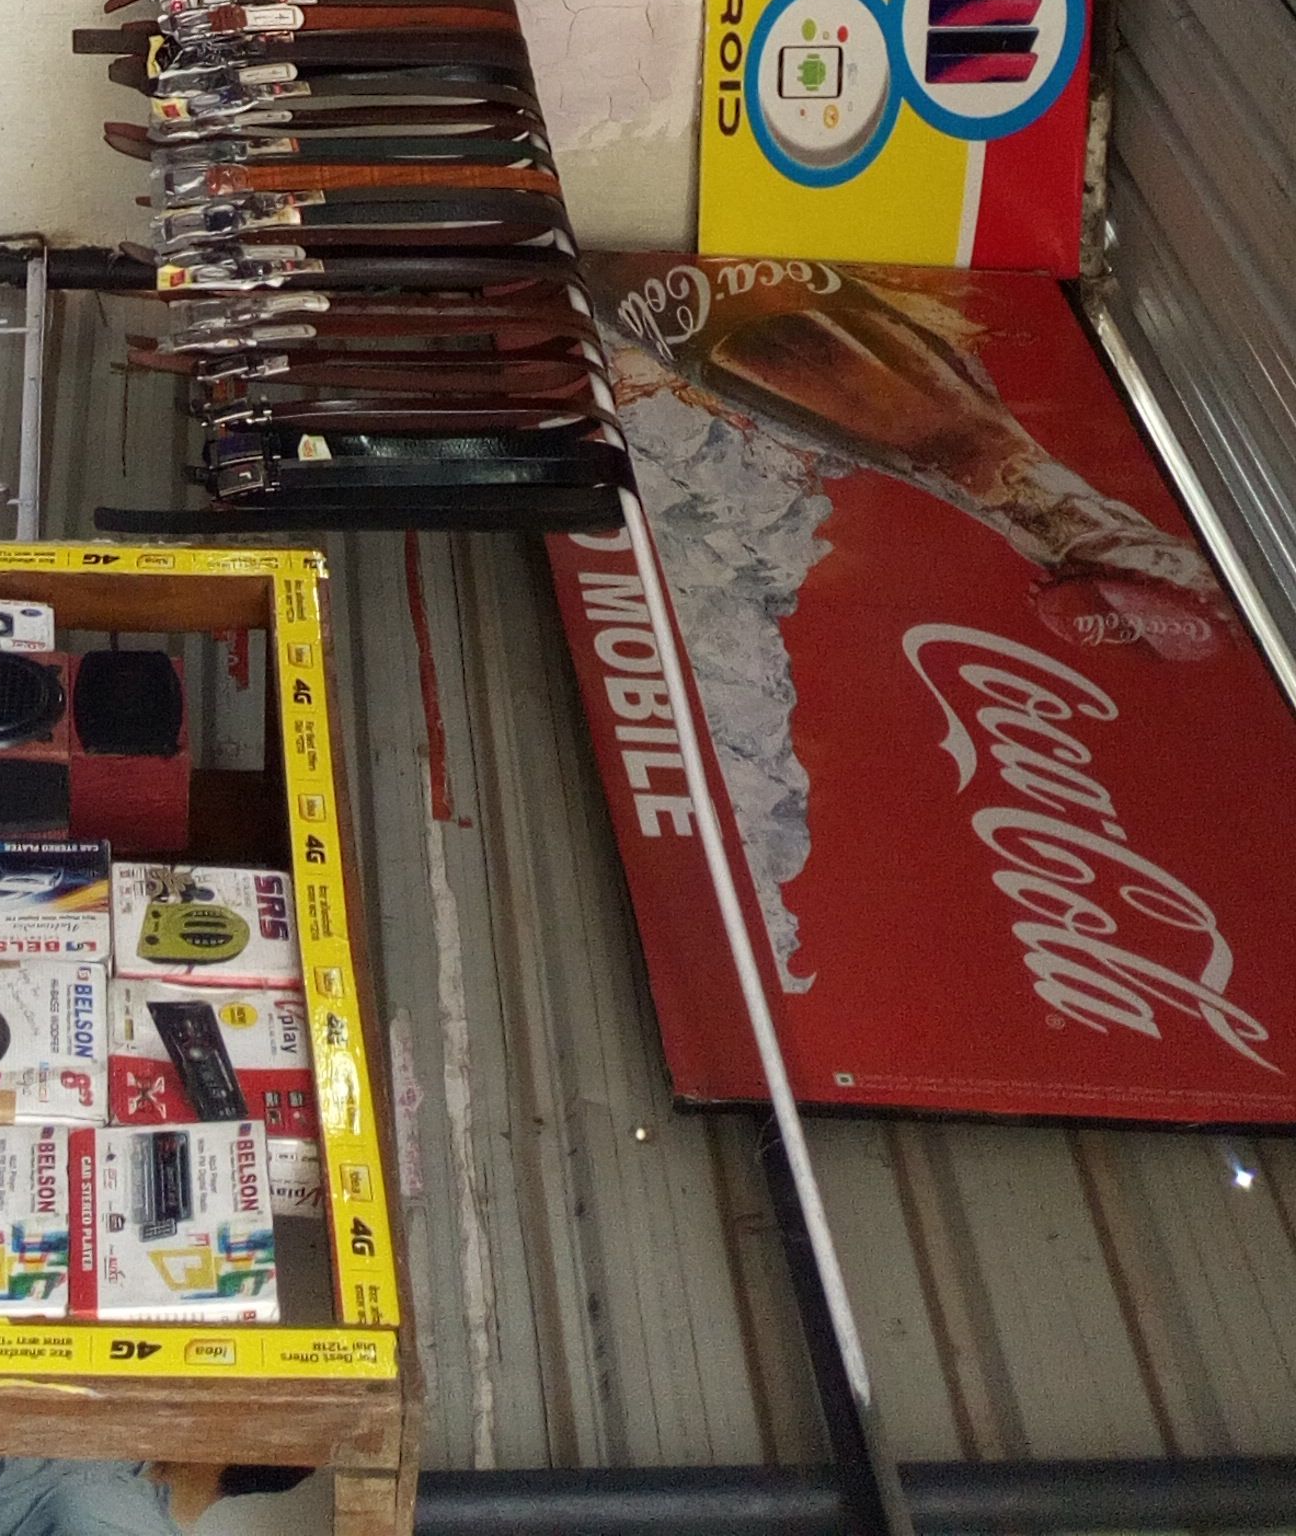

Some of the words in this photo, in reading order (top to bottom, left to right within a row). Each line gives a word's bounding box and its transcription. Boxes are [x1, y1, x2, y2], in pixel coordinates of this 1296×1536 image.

[293, 678, 313, 705] 4G
[577, 572, 700, 838] MOBILE
[305, 834, 326, 864] 4G
[902, 622, 1284, 1076] Coca-Cola
[50, 1015, 61, 1054] WOOFER
[74, 984, 94, 1058] BELSON
[37, 1143, 56, 1213] BELSON
[81, 1155, 92, 1181] CAR
[236, 1139, 259, 1212] BELSON
[81, 1182, 93, 1226] STEREO
[81, 1228, 93, 1272] PLAYER
[350, 1217, 375, 1257] 4G
[109, 1340, 163, 1360] 4G
